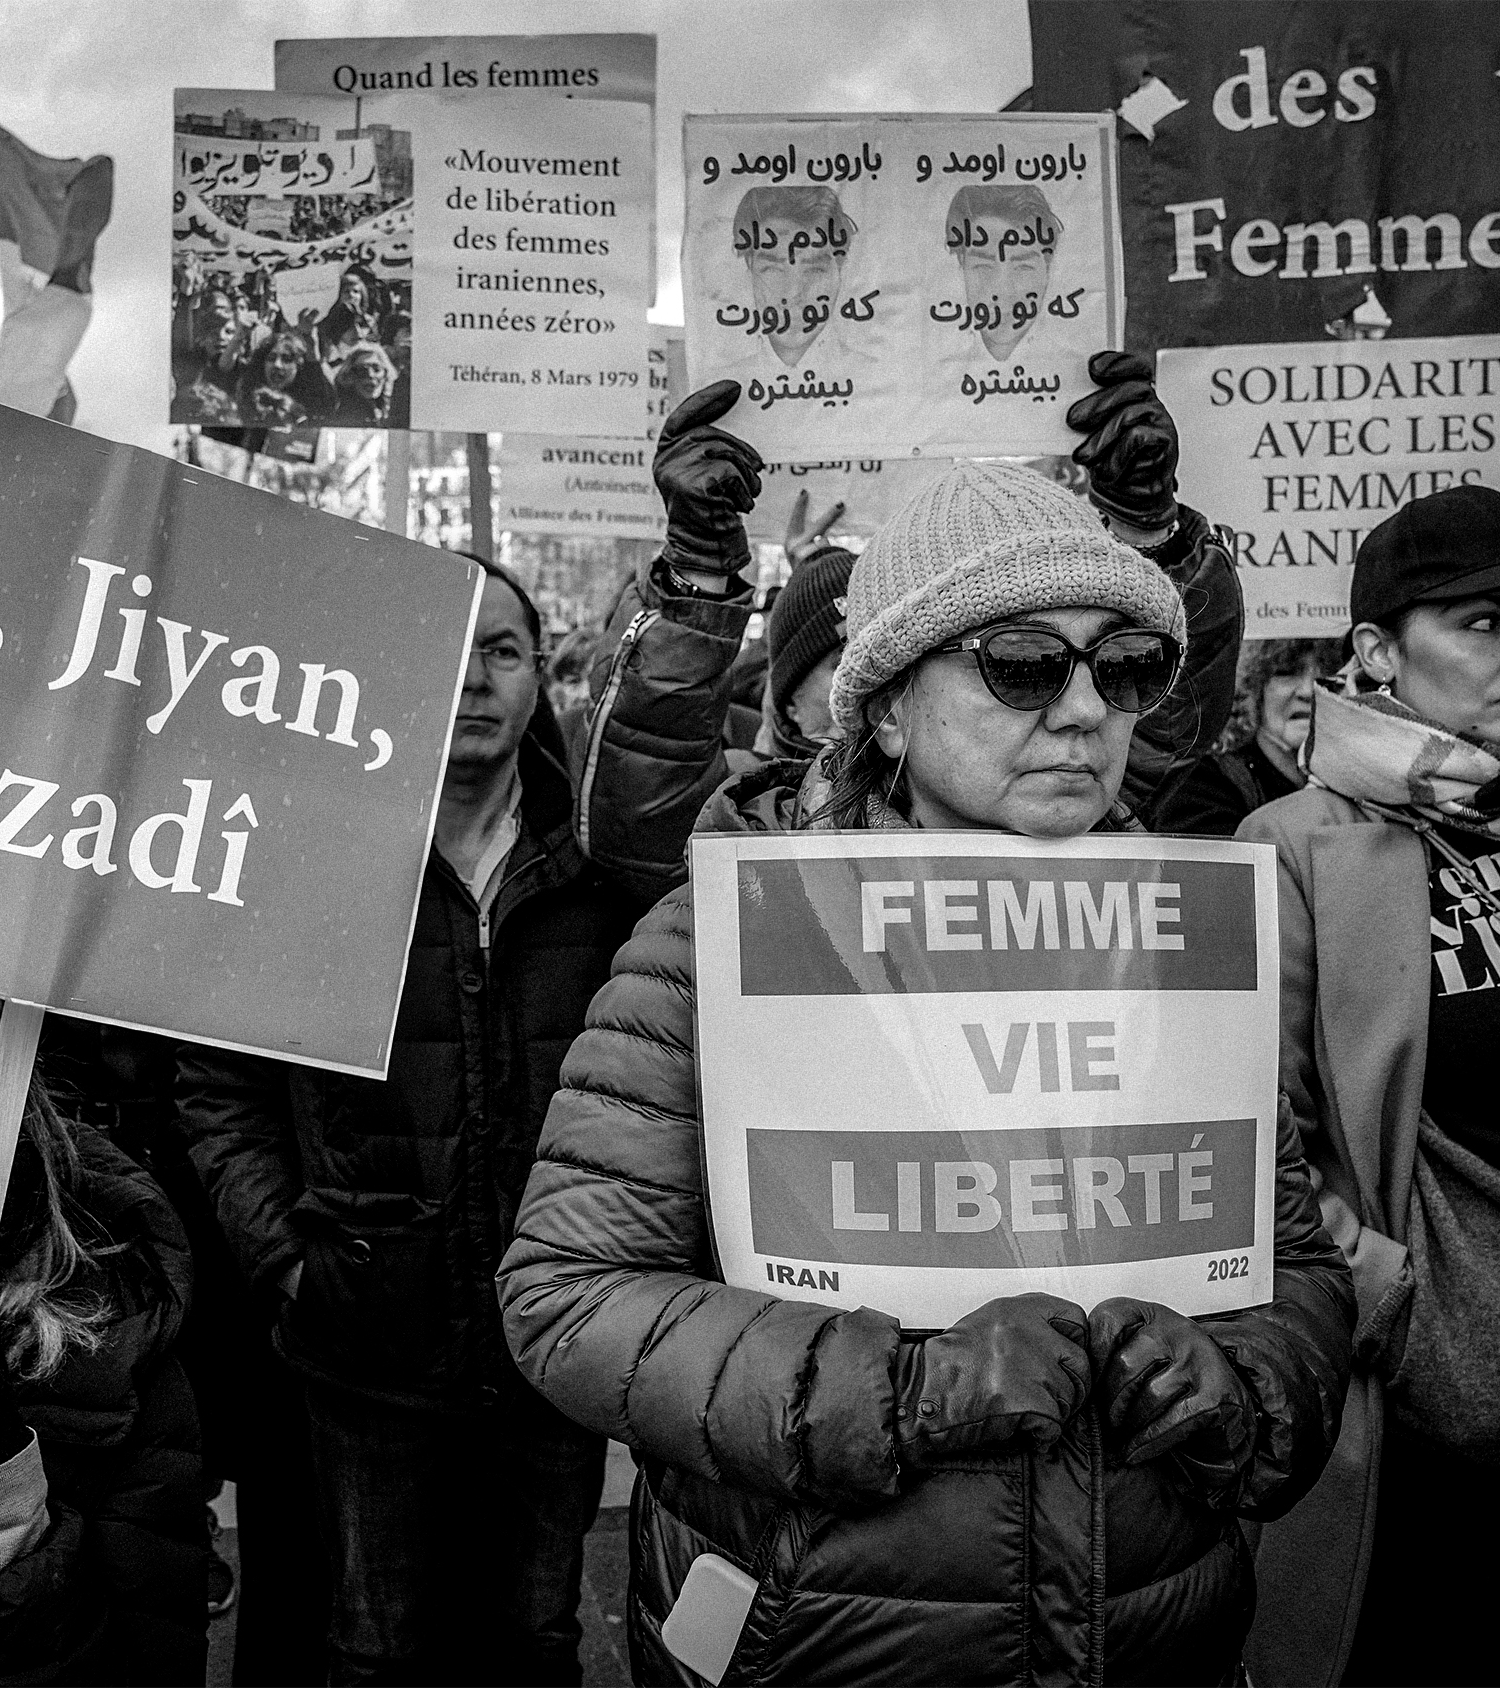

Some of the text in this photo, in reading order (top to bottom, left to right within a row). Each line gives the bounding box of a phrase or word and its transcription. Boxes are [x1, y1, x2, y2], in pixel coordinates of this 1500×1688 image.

[332, 60, 599, 95] Quand les femmes
[1212, 46, 1376, 132] des
[444, 148, 621, 178] «Mouvement
[703, 141, 883, 185] بارون اومد و
[916, 142, 1087, 183] بارون اومد و
[445, 185, 617, 217] de libération
[452, 225, 610, 256] des femmes
[734, 216, 848, 265] یادم داد
[946, 215, 1055, 262] یادم داد
[456, 265, 605, 298] iraniennes,
[443, 309, 616, 334] années zéro»
[716, 289, 881, 335] که تو زورت
[930, 287, 1086, 330] که تو زورت
[448, 364, 640, 388] Téhéran, 8 Mars 1979
[747, 369, 854, 411] بیشتره
[960, 364, 1061, 405] بیشتره
[1250, 413, 1496, 459] AVEC LES
[542, 448, 645, 468] avancent
[1255, 601, 1290, 619] des
[47, 556, 394, 772] Jiyan,
[861, 880, 1185, 953] FEMME
[961, 1021, 1120, 1094] VIE
[831, 1133, 1214, 1233] LIBERTÉ
[765, 1254, 1250, 1292] IRAN 2022
